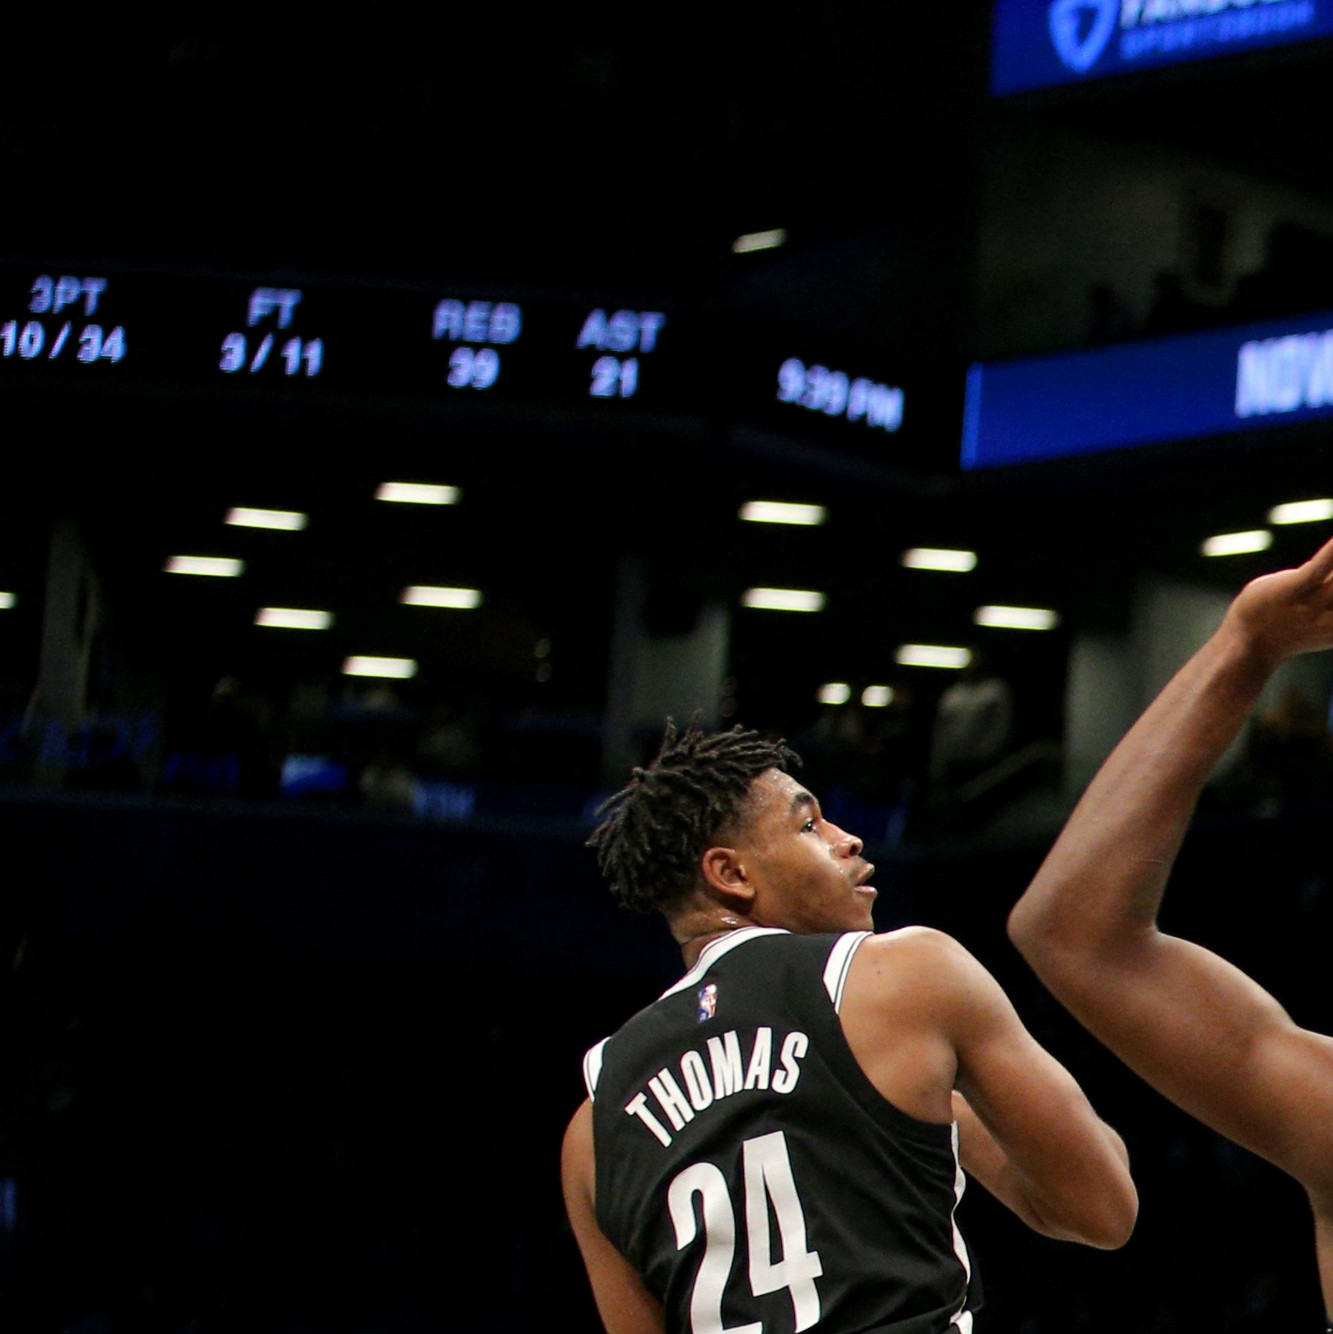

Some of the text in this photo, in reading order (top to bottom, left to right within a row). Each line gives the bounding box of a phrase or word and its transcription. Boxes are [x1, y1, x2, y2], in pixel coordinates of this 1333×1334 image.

[27, 274, 108, 317] 3PT
[246, 286, 302, 329] FT
[576, 307, 667, 353] AST
[589, 355, 639, 398] 21
[625, 1027, 808, 1148] THOMAS
